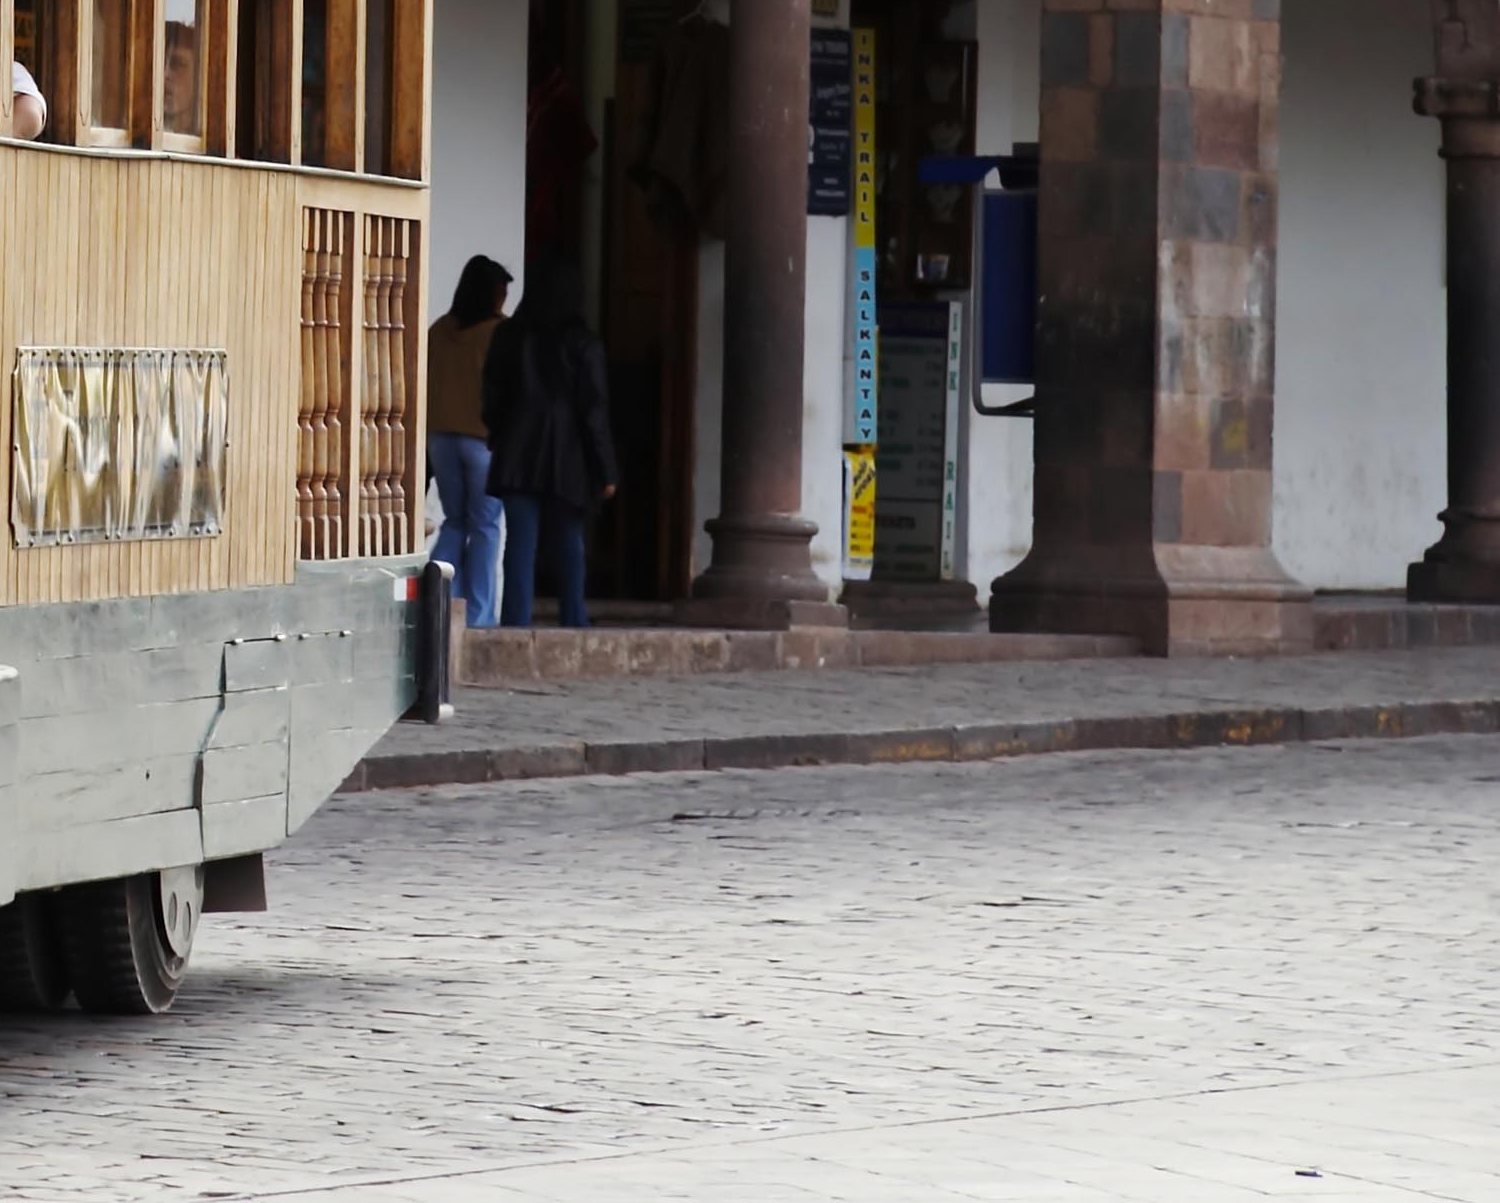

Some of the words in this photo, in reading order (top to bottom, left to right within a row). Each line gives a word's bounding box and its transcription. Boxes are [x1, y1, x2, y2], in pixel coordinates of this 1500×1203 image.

[857, 33, 871, 106] INKA
[858, 132, 871, 223] TRAIL
[859, 270, 873, 441] SALKANTAY
